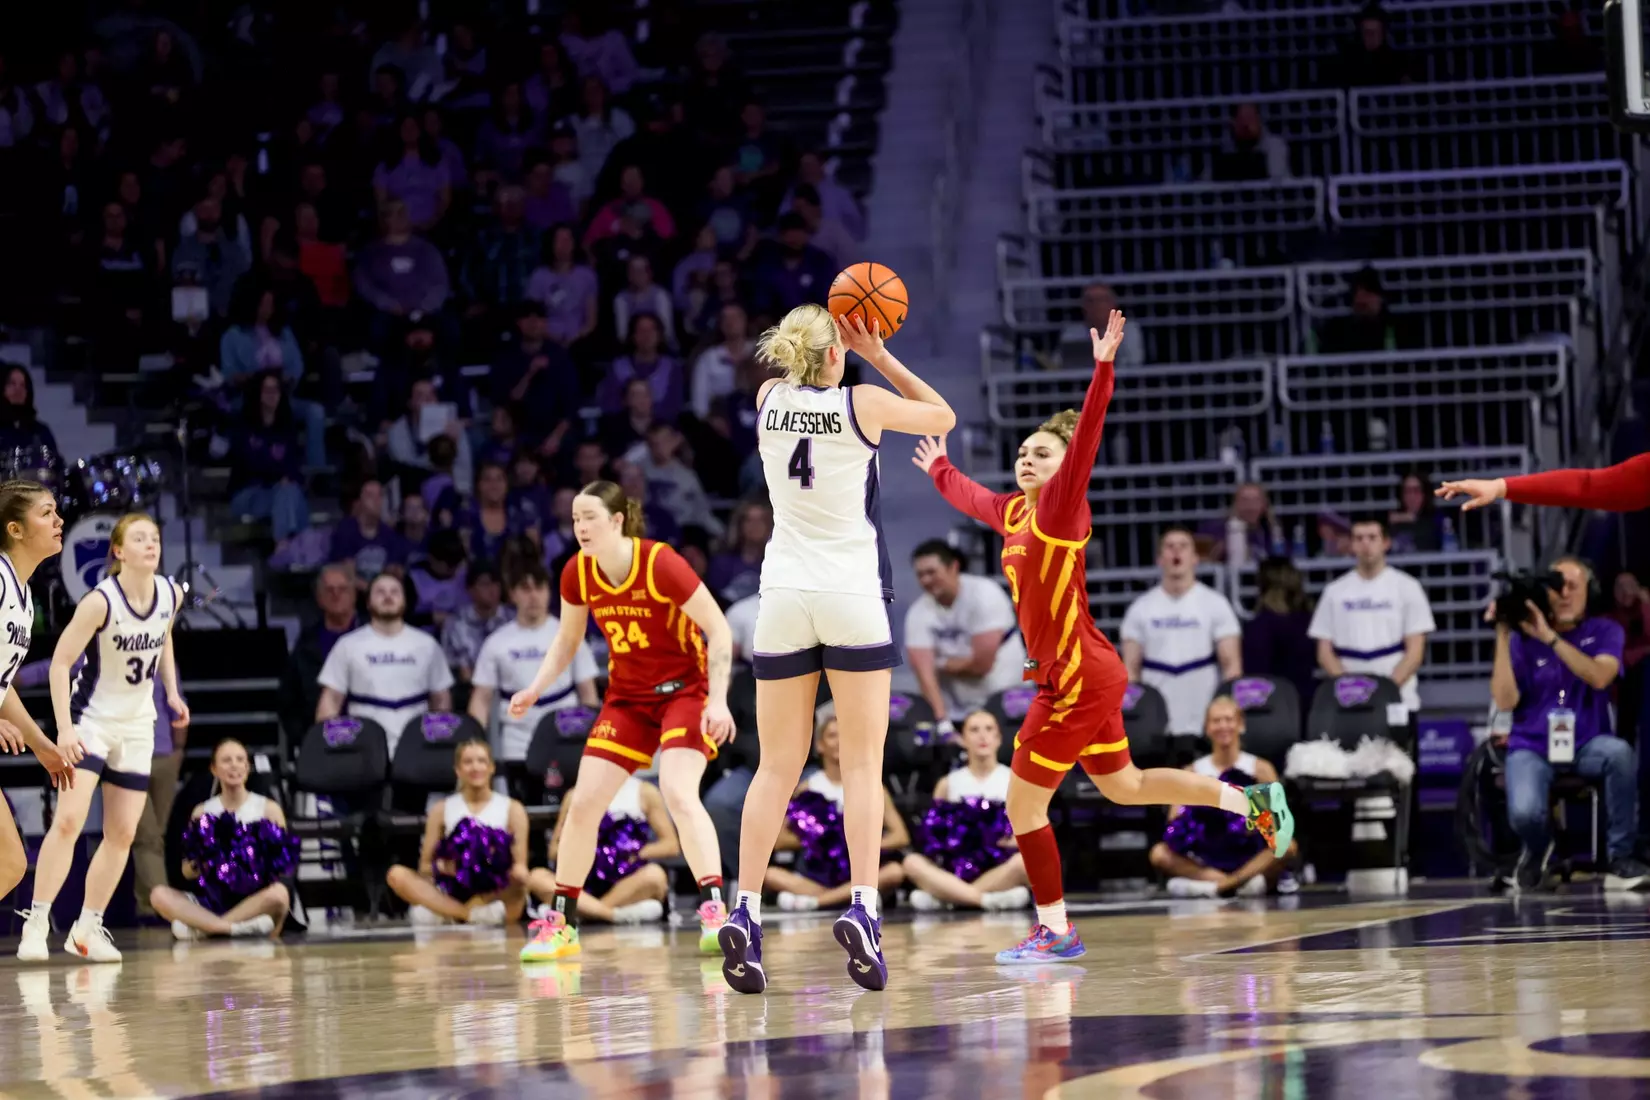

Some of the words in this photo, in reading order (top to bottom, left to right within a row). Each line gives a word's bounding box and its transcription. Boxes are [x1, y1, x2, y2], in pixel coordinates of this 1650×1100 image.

[766, 409, 842, 434] CLAESSENS
[788, 437, 815, 489] 4
[616, 606, 652, 618] STATE
[112, 631, 165, 652] Wildcat
[605, 621, 650, 653] 24
[125, 655, 158, 685] 34
